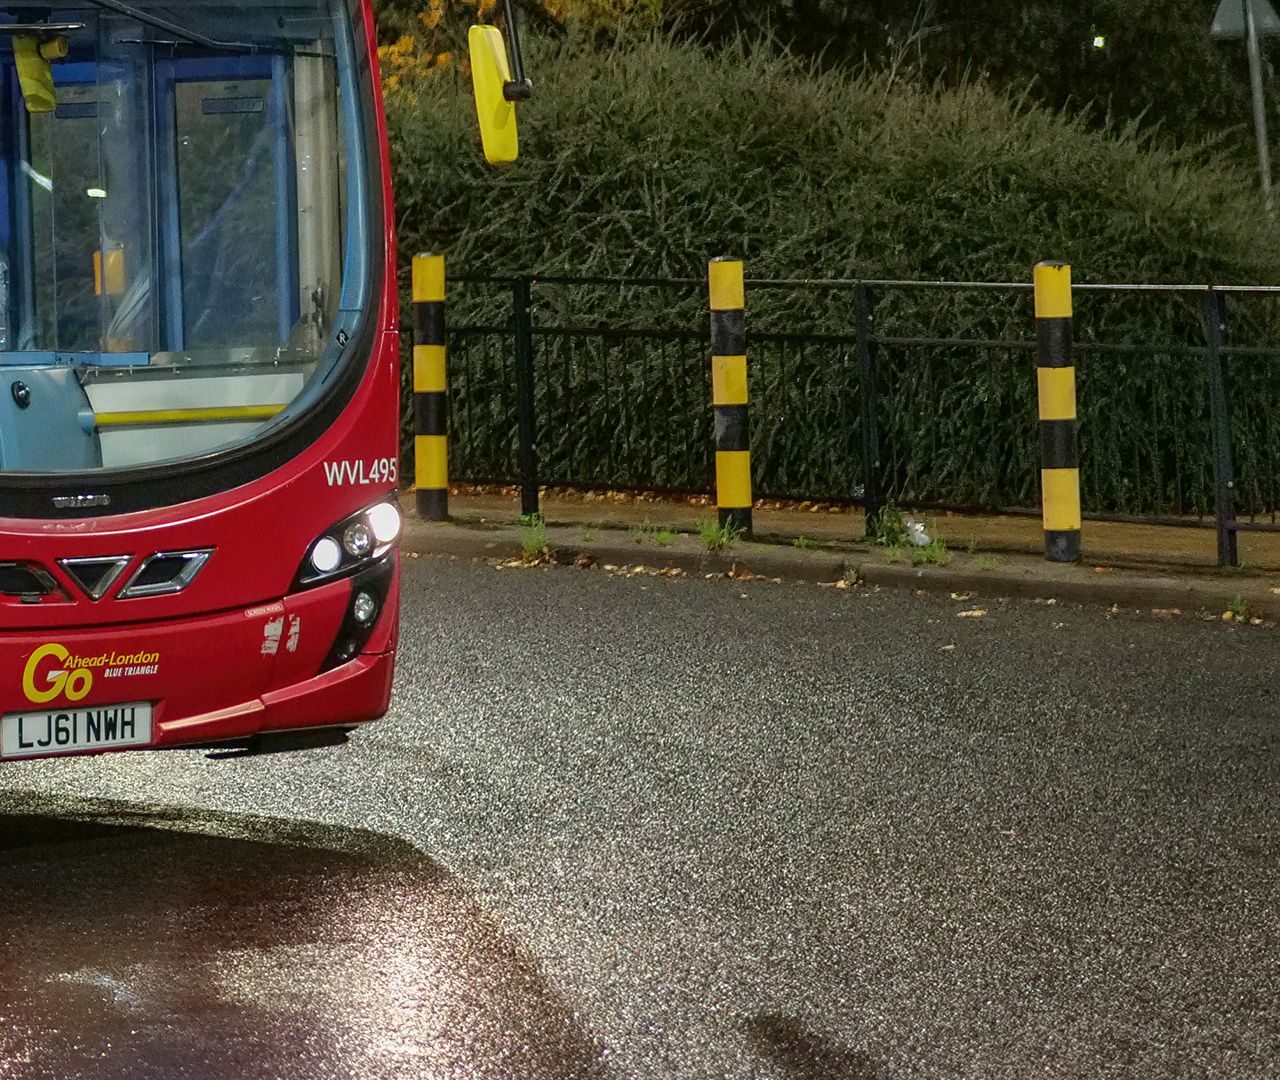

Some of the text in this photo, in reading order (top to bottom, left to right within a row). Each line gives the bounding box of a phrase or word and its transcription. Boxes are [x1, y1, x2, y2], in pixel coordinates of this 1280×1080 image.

[323, 457, 397, 486] WVL495
[22, 643, 93, 703] Go
[104, 665, 158, 678] BLUE TRIANGLE
[18, 707, 135, 749] LJ61 NWH
